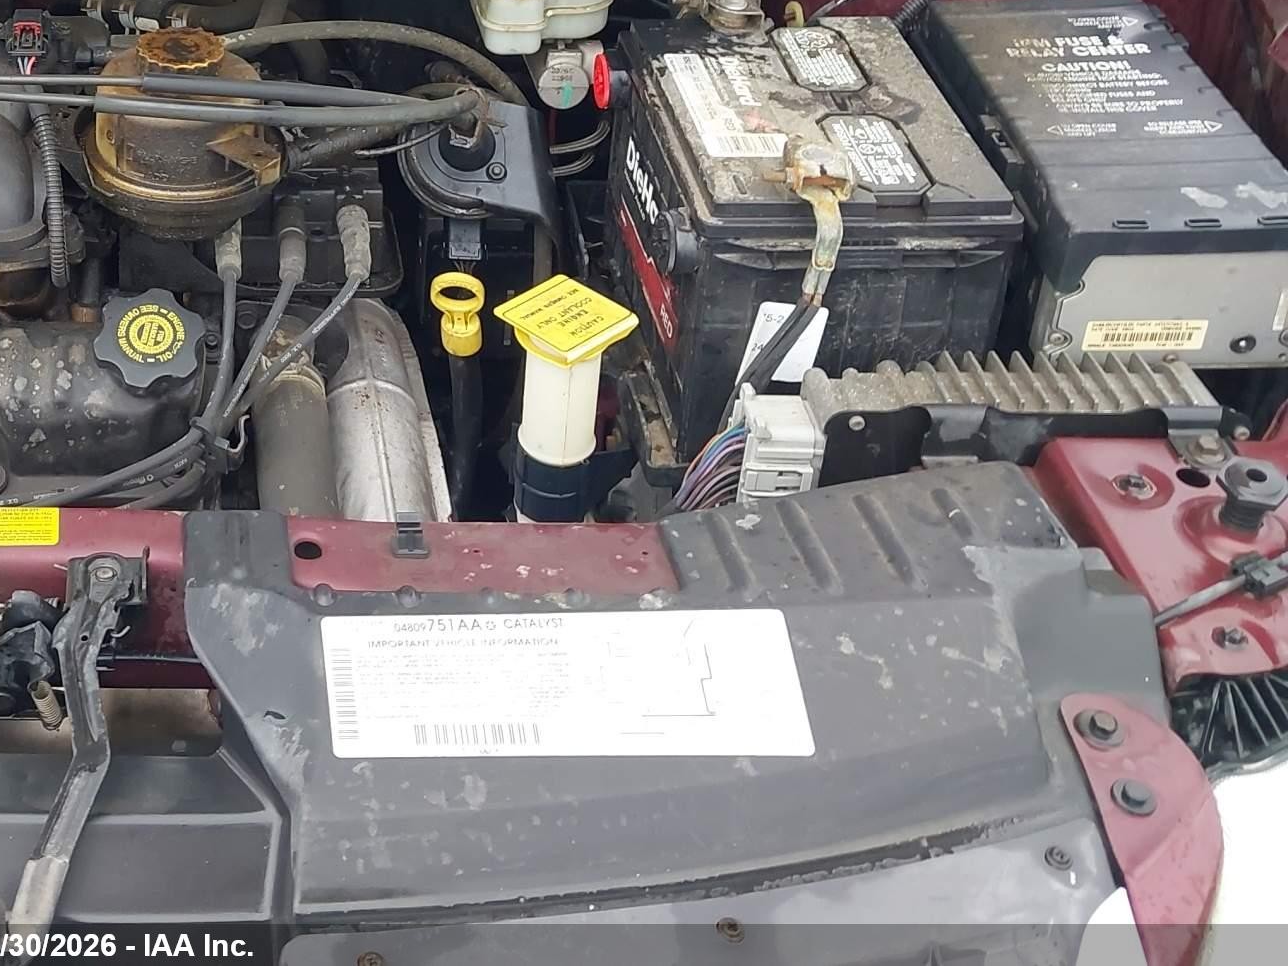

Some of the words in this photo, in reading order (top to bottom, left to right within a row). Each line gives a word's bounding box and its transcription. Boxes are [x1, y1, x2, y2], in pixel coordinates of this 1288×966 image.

[1054, 35, 1104, 47] FUSE
[1005, 46, 1065, 57] RELAY
[1071, 43, 1152, 57] CENTER
[1041, 60, 1132, 72] CAUTION!
[139, 304, 160, 314] SEE
[557, 296, 593, 319] COOLANT
[536, 316, 559, 330] ONLY
[560, 309, 589, 328] ENGINE
[659, 303, 674, 339] RED
[166, 311, 186, 341] ENGINE
[569, 315, 605, 337] CAUTION
[117, 336, 145, 364] MANUAL
[155, 351, 173, 364] OIL
[503, 617, 565, 630] CATALYST
[368, 639, 431, 649] IMPORTANT
[480, 637, 559, 648] INFORMATION
